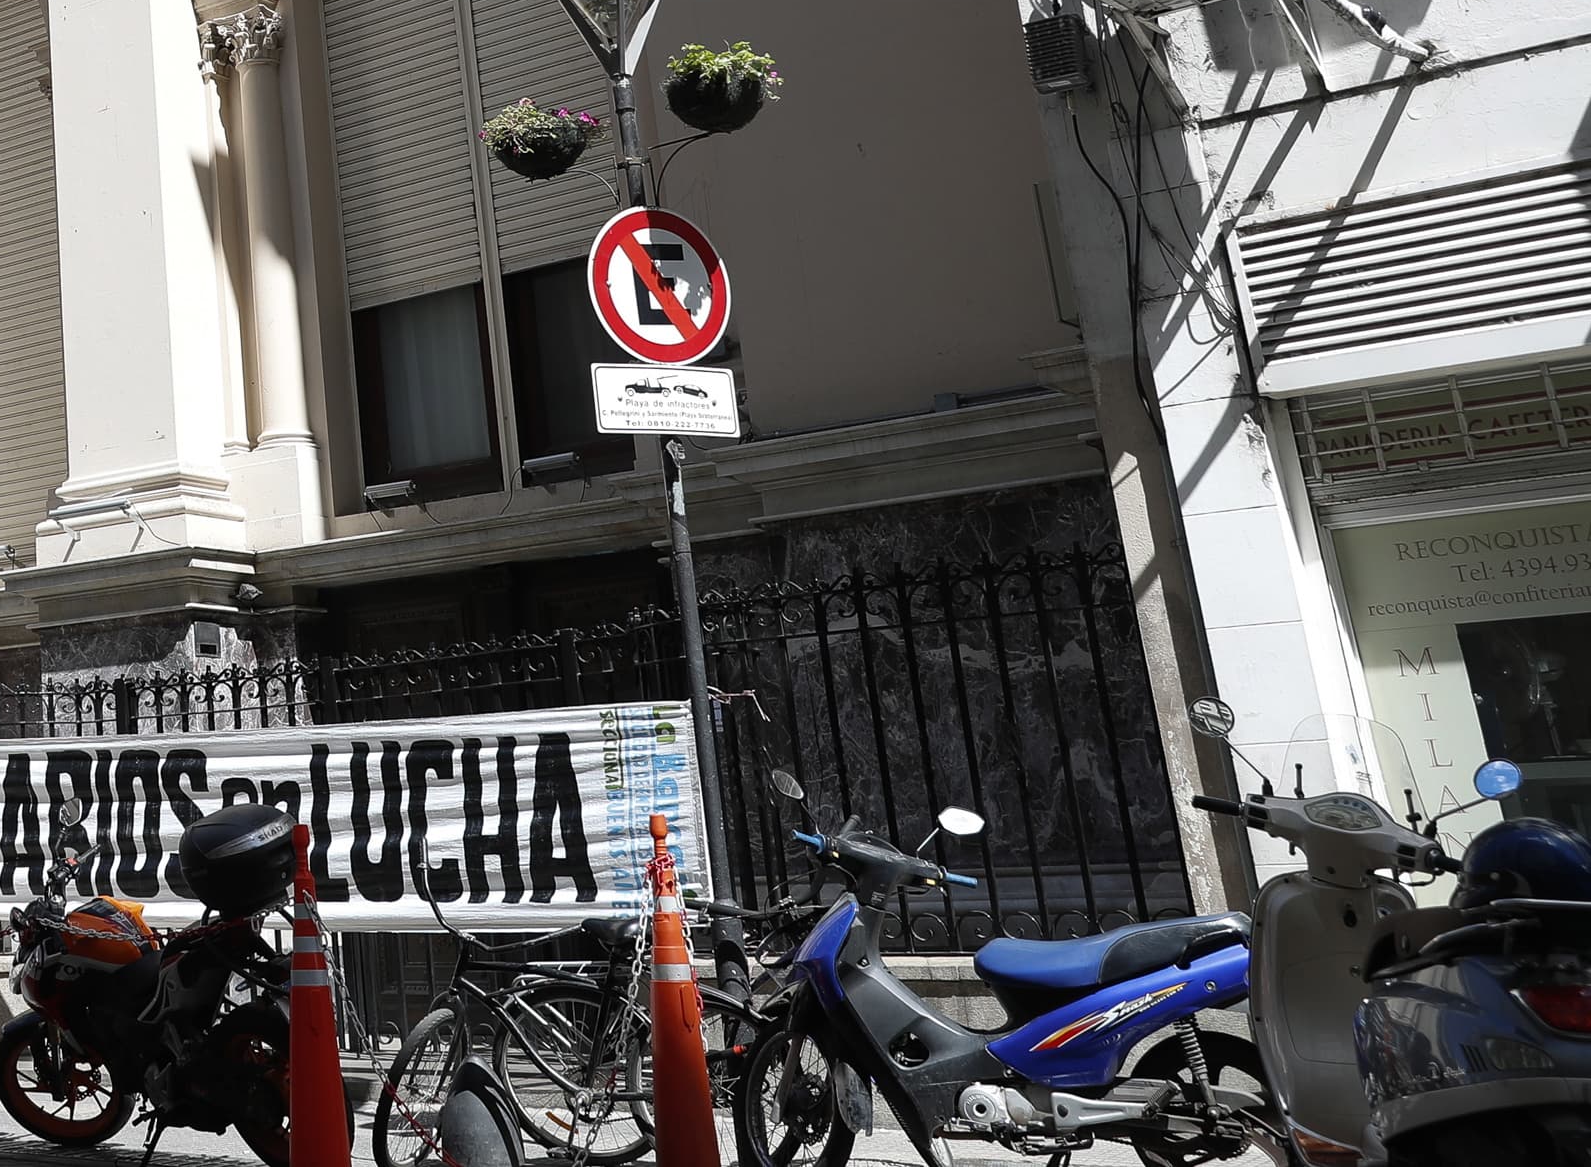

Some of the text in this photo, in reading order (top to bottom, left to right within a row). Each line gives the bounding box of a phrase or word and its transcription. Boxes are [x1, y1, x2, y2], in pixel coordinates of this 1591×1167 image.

[633, 244, 692, 325] E
[625, 398, 649, 408] Playa
[667, 400, 710, 410] infractores
[1450, 561, 1496, 583] Tel:
[310, 733, 599, 903] LUCHA
[607, 791, 627, 860] BUENOS
